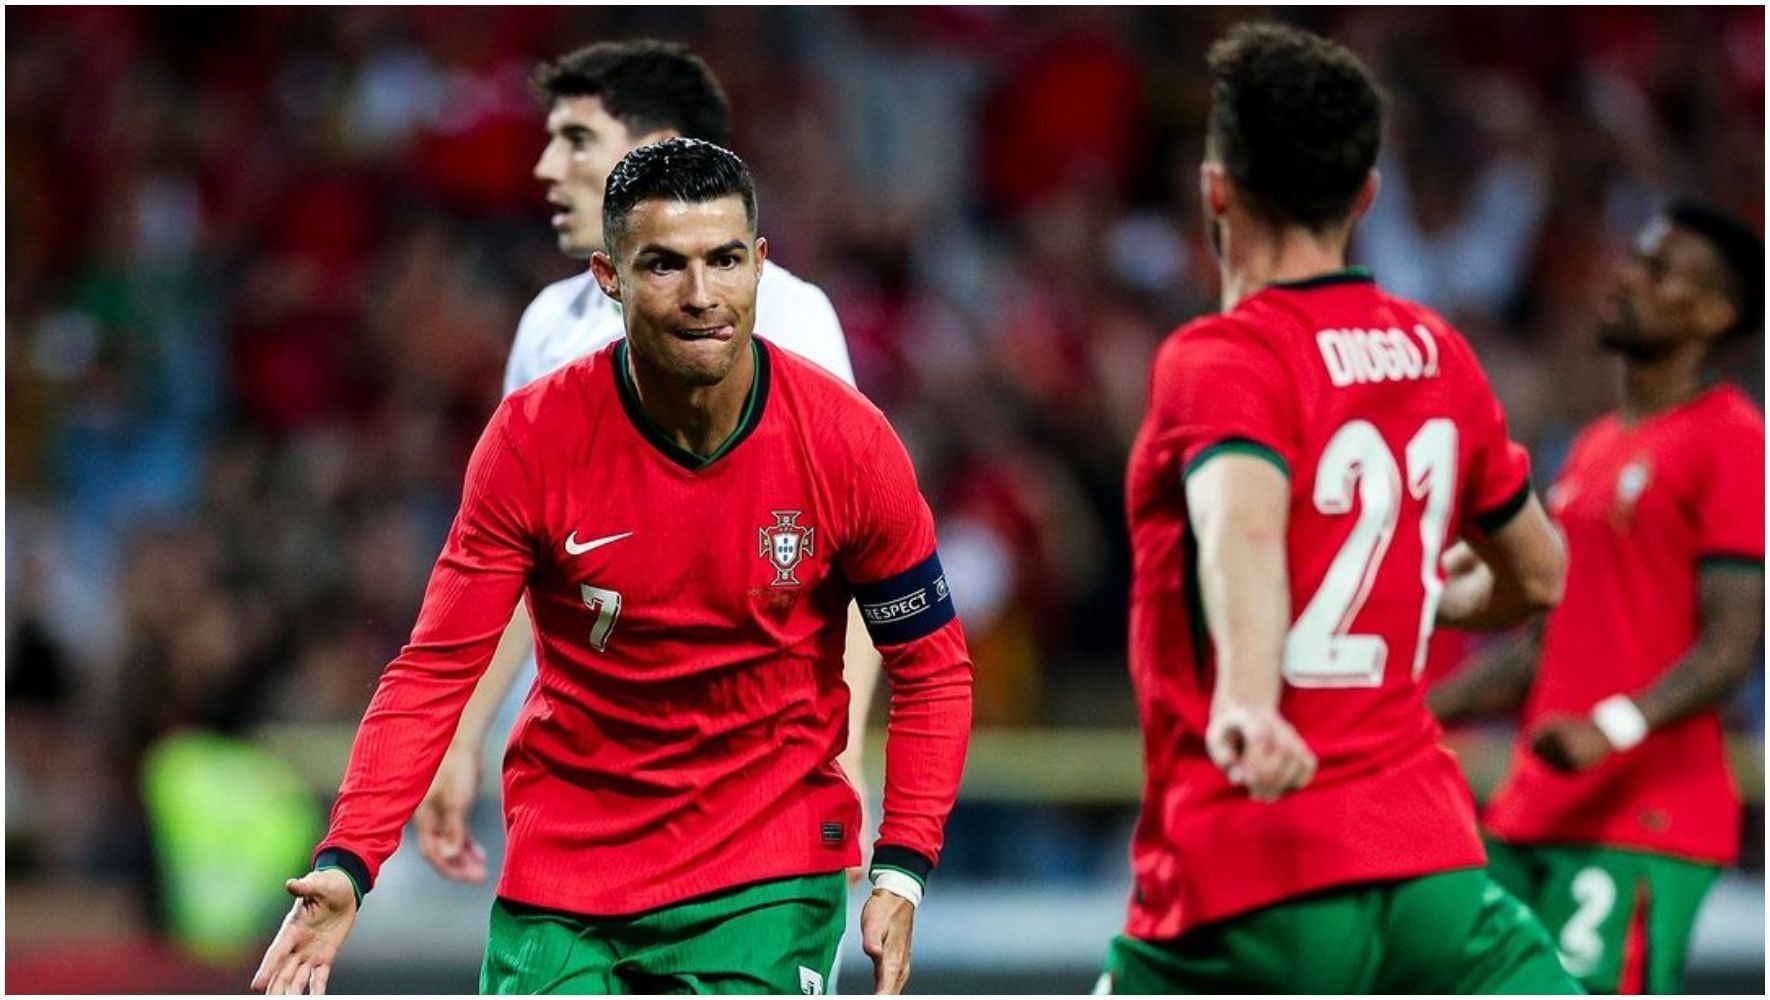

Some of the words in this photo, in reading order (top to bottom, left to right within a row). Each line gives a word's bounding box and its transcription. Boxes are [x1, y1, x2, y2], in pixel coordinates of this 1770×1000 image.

[1315, 328, 1422, 388] DIOGO
[1283, 418, 1459, 688] 21
[581, 583, 622, 653] 7
[864, 593, 927, 620] RESPECT
[1560, 866, 1617, 978] 2
